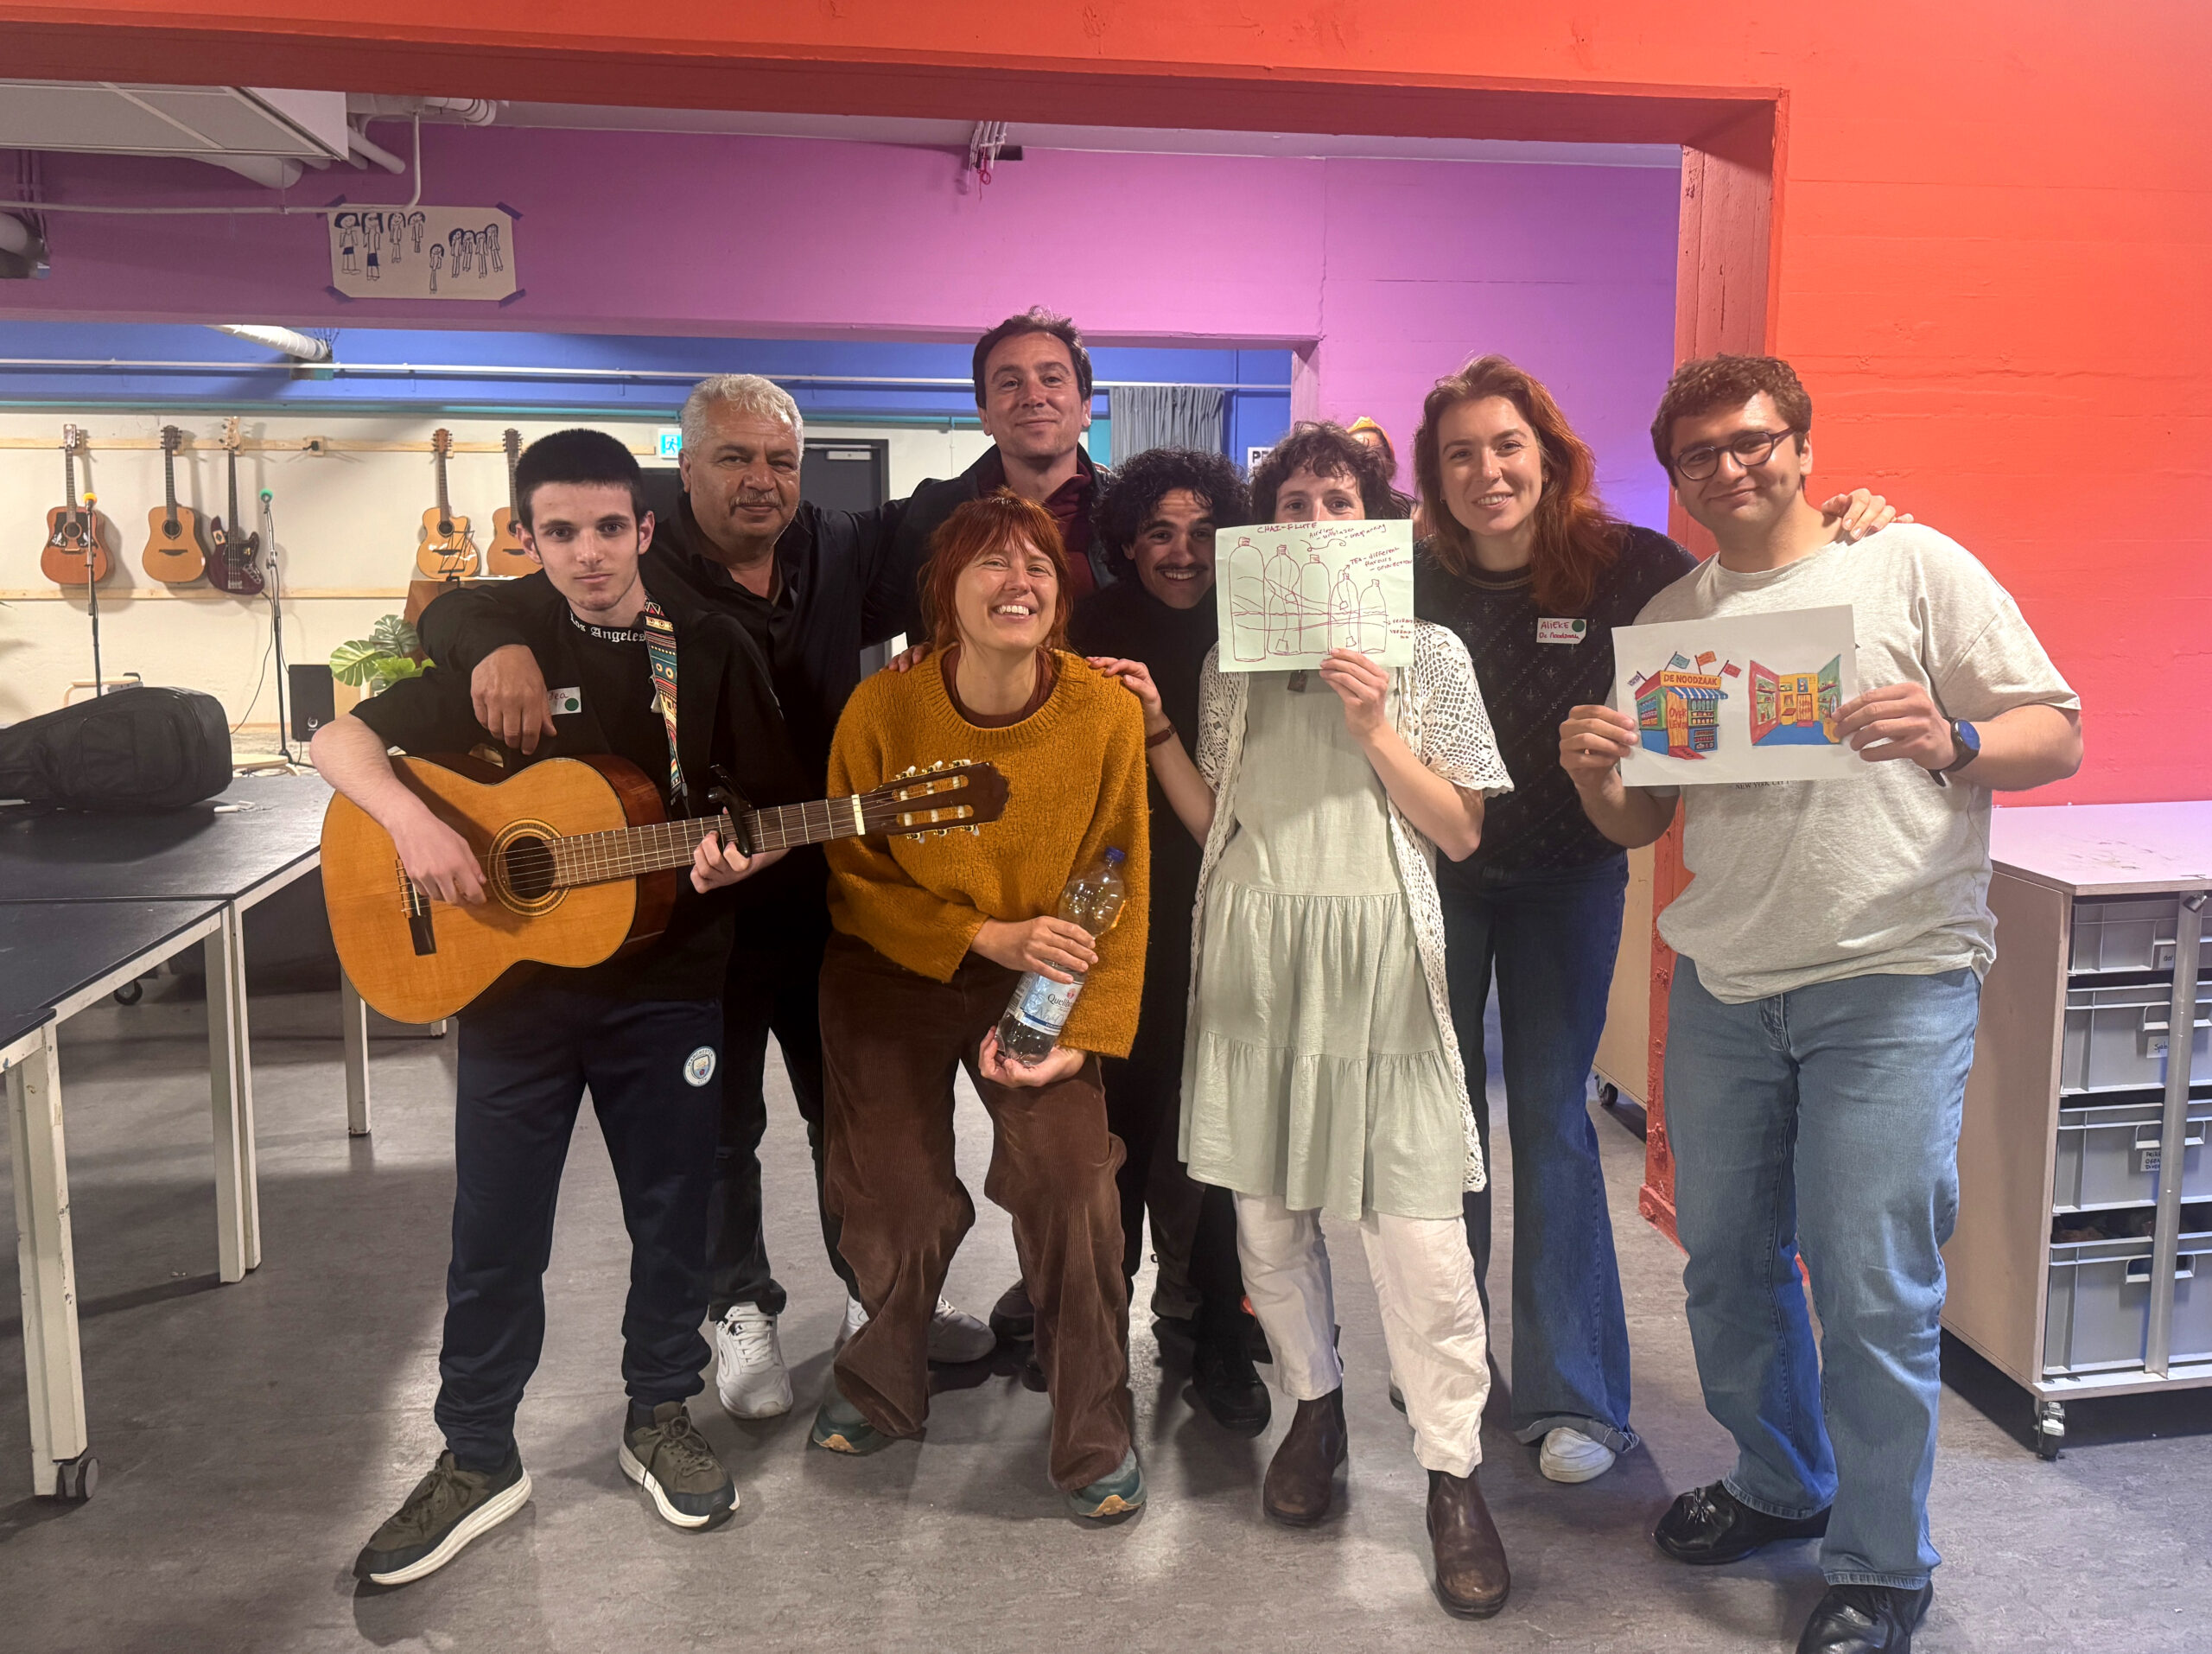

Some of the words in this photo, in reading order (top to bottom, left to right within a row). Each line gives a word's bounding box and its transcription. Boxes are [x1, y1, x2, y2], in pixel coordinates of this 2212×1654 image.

[1369, 547, 1400, 559] different
[569, 609, 586, 632] Los
[590, 627, 646, 643] Angeles
[1676, 675, 1717, 685] NOODZAAK
[1669, 708, 1687, 719] OVER
